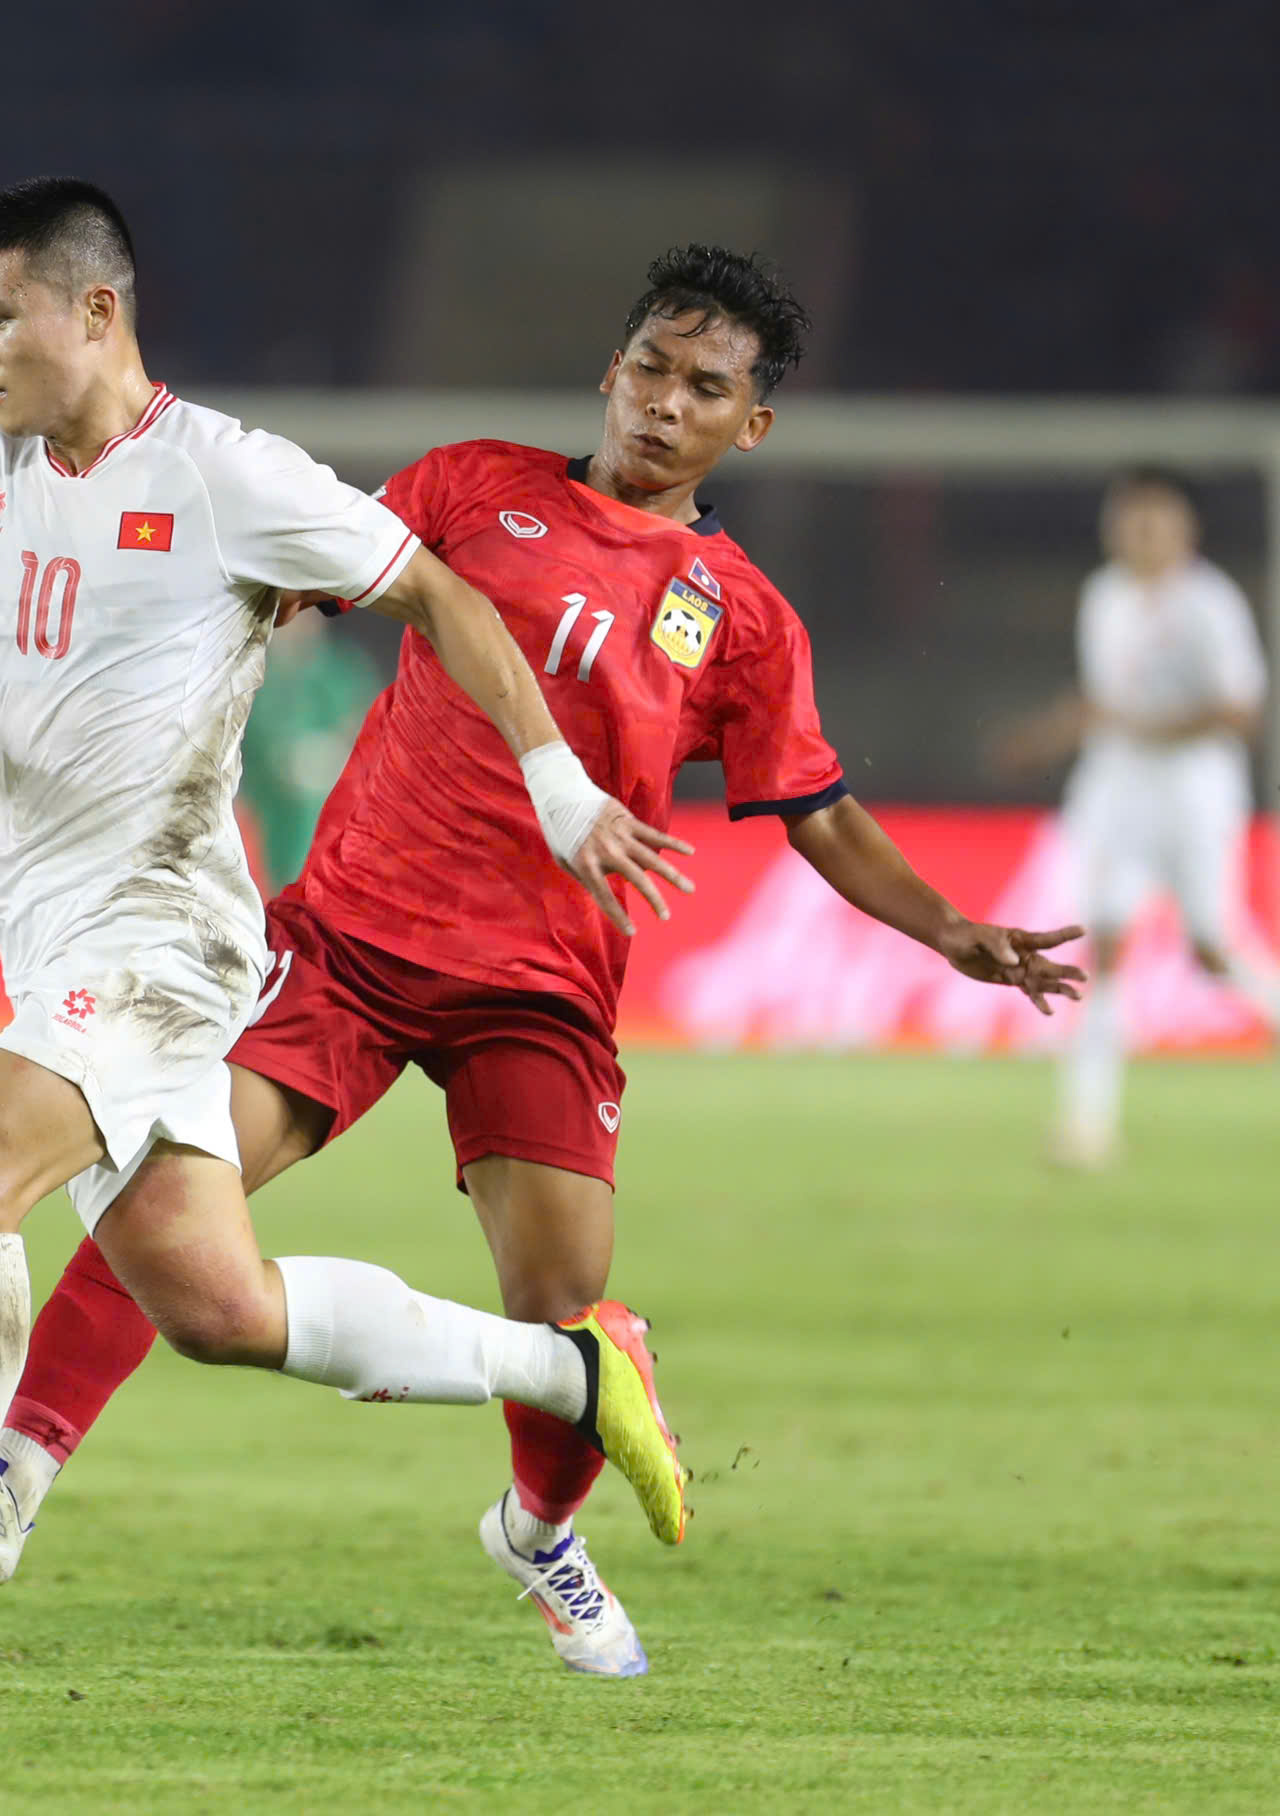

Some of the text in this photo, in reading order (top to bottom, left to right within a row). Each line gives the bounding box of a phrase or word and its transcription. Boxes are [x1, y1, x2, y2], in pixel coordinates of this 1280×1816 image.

[16, 550, 81, 660] 10
[544, 592, 616, 683] 11
[681, 589, 710, 613] LAOS
